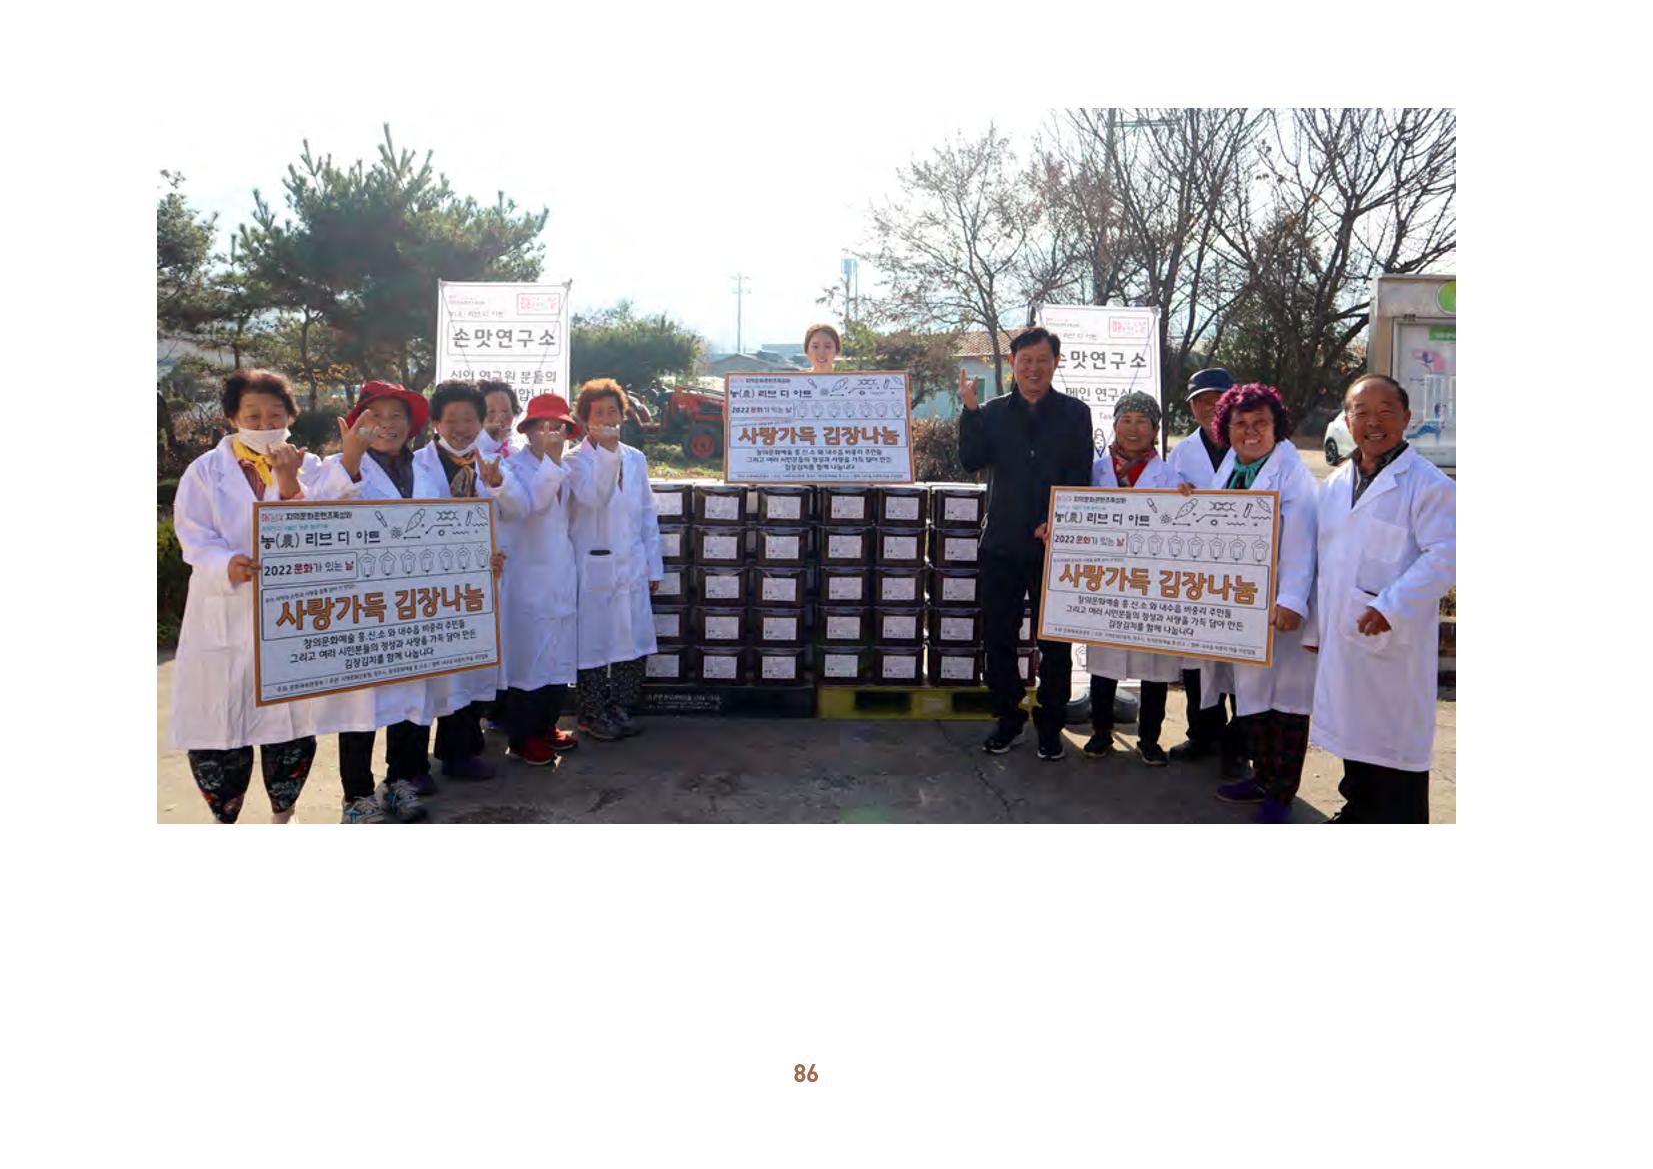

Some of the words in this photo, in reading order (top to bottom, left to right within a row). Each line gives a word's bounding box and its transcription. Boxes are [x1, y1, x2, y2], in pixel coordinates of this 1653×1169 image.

[452, 328, 556, 348] 손맛연구소
[738, 426, 817, 446] 사랑가득
[823, 426, 900, 446] 김장나눔
[1087, 513, 1108, 524] 리브
[1113, 513, 1122, 525] 디
[1129, 514, 1150, 527] 아트
[305, 531, 332, 546] 리브
[337, 531, 350, 545] 디
[356, 530, 381, 544] 아트
[1055, 535, 1075, 544] 2022
[264, 564, 292, 577] 2022
[294, 562, 322, 575] 문화가
[324, 561, 343, 572] 있는
[345, 560, 354, 571] 날
[1059, 564, 1151, 596] 사랑가득
[1159, 570, 1258, 605] 김장나눔
[276, 592, 387, 632] 사랑가득
[395, 583, 485, 620] 김장나눔
[290, 651, 317, 663] 그리고
[319, 648, 337, 659] 여러
[794, 1063, 819, 1083] 86
